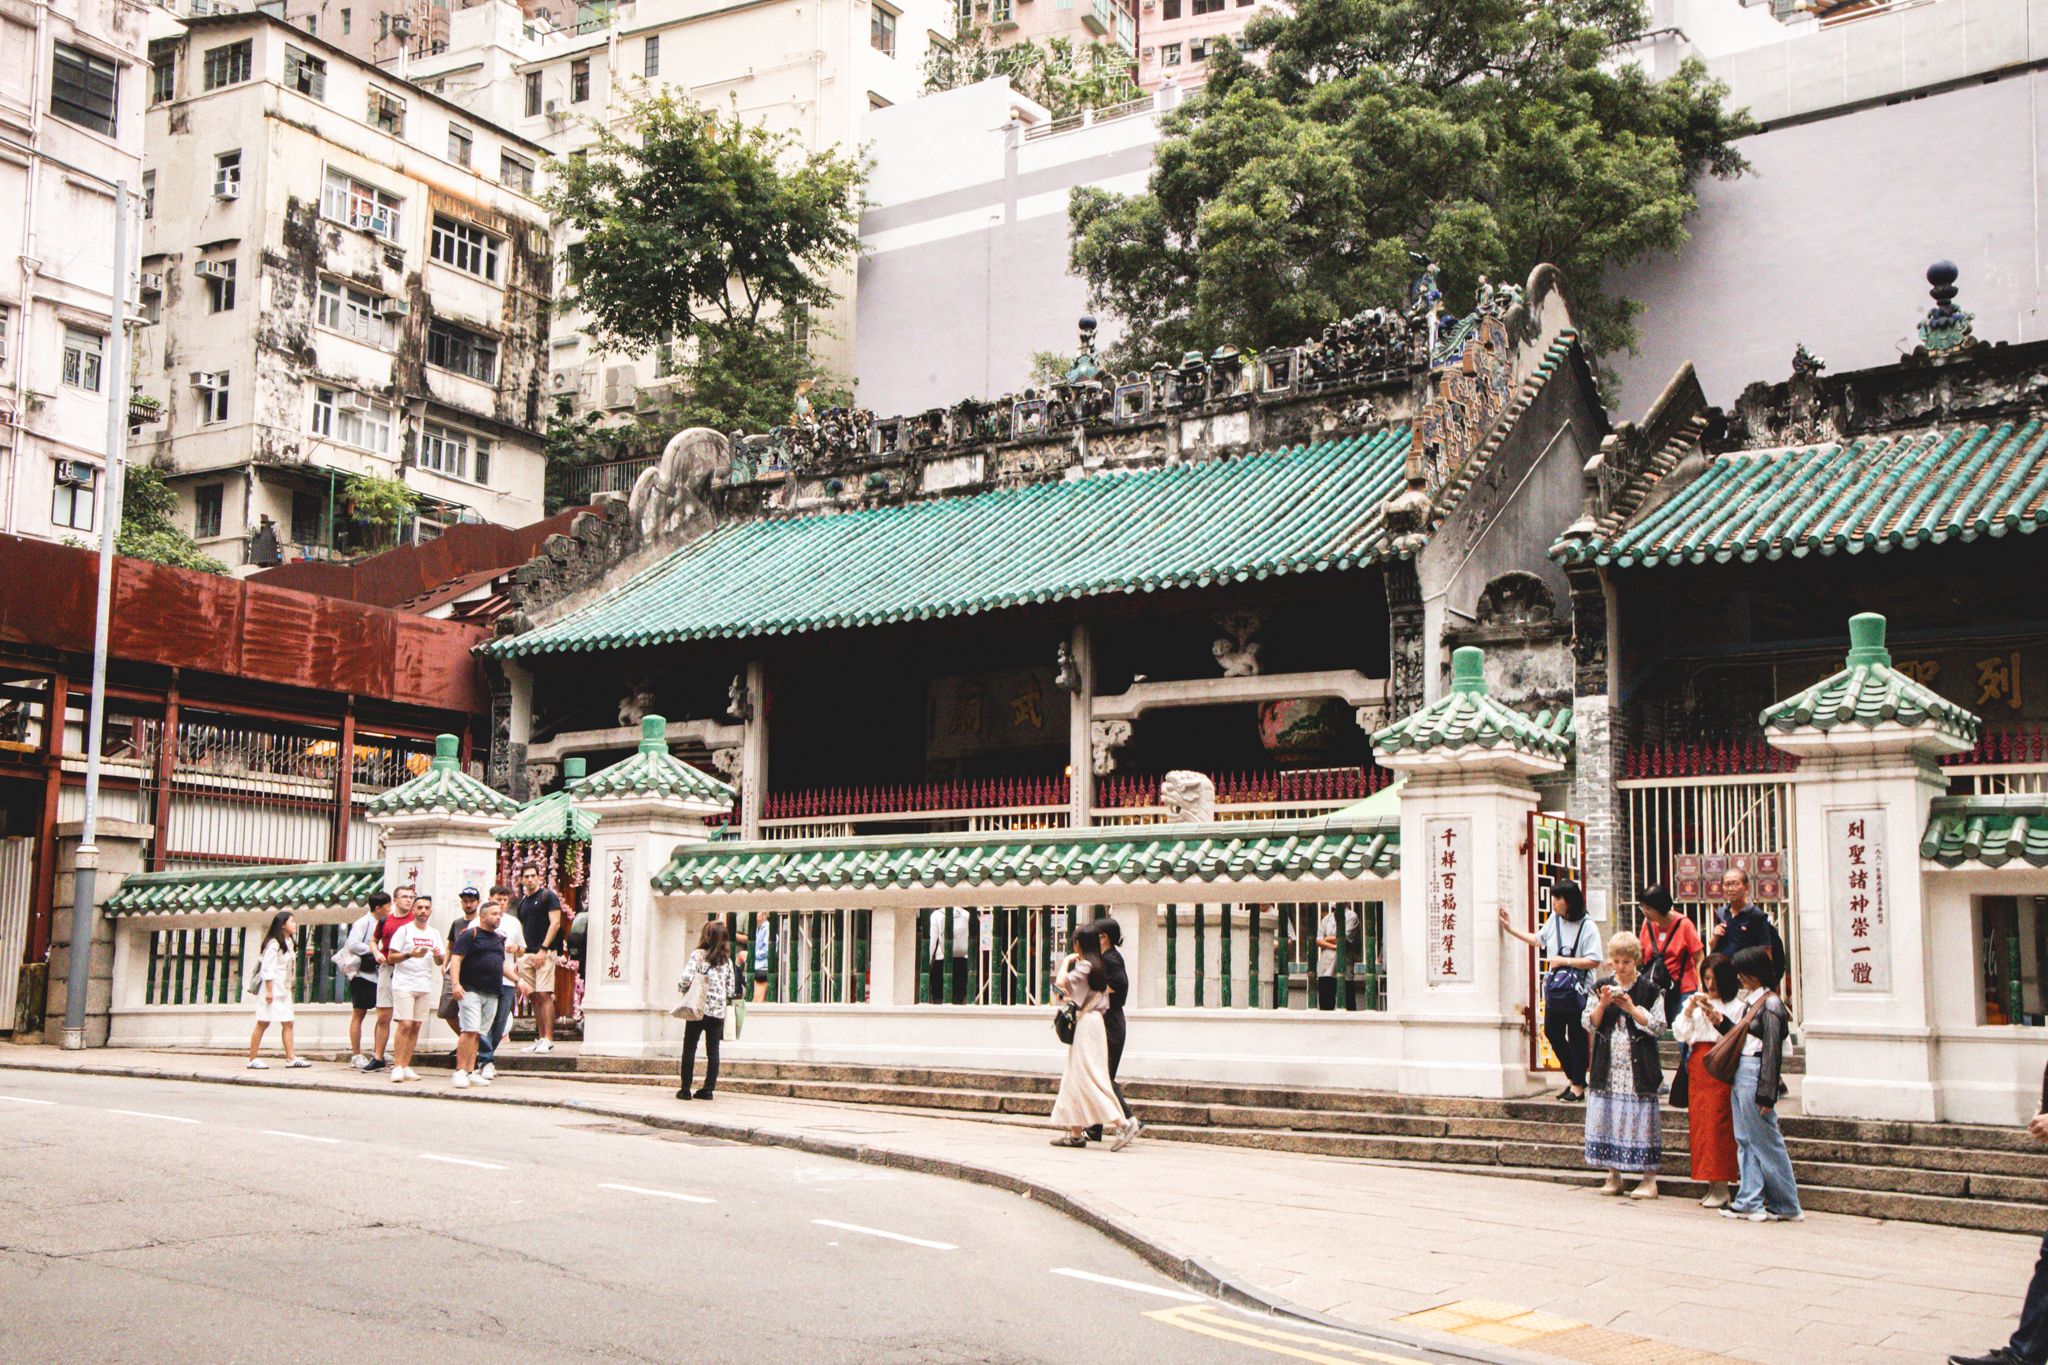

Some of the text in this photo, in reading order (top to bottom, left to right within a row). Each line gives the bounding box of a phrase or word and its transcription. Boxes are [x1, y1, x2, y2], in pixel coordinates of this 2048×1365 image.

[608, 856, 624, 978] 文德武功雙帝祀
[1848, 819, 1872, 984] 列聖諸神崇一體
